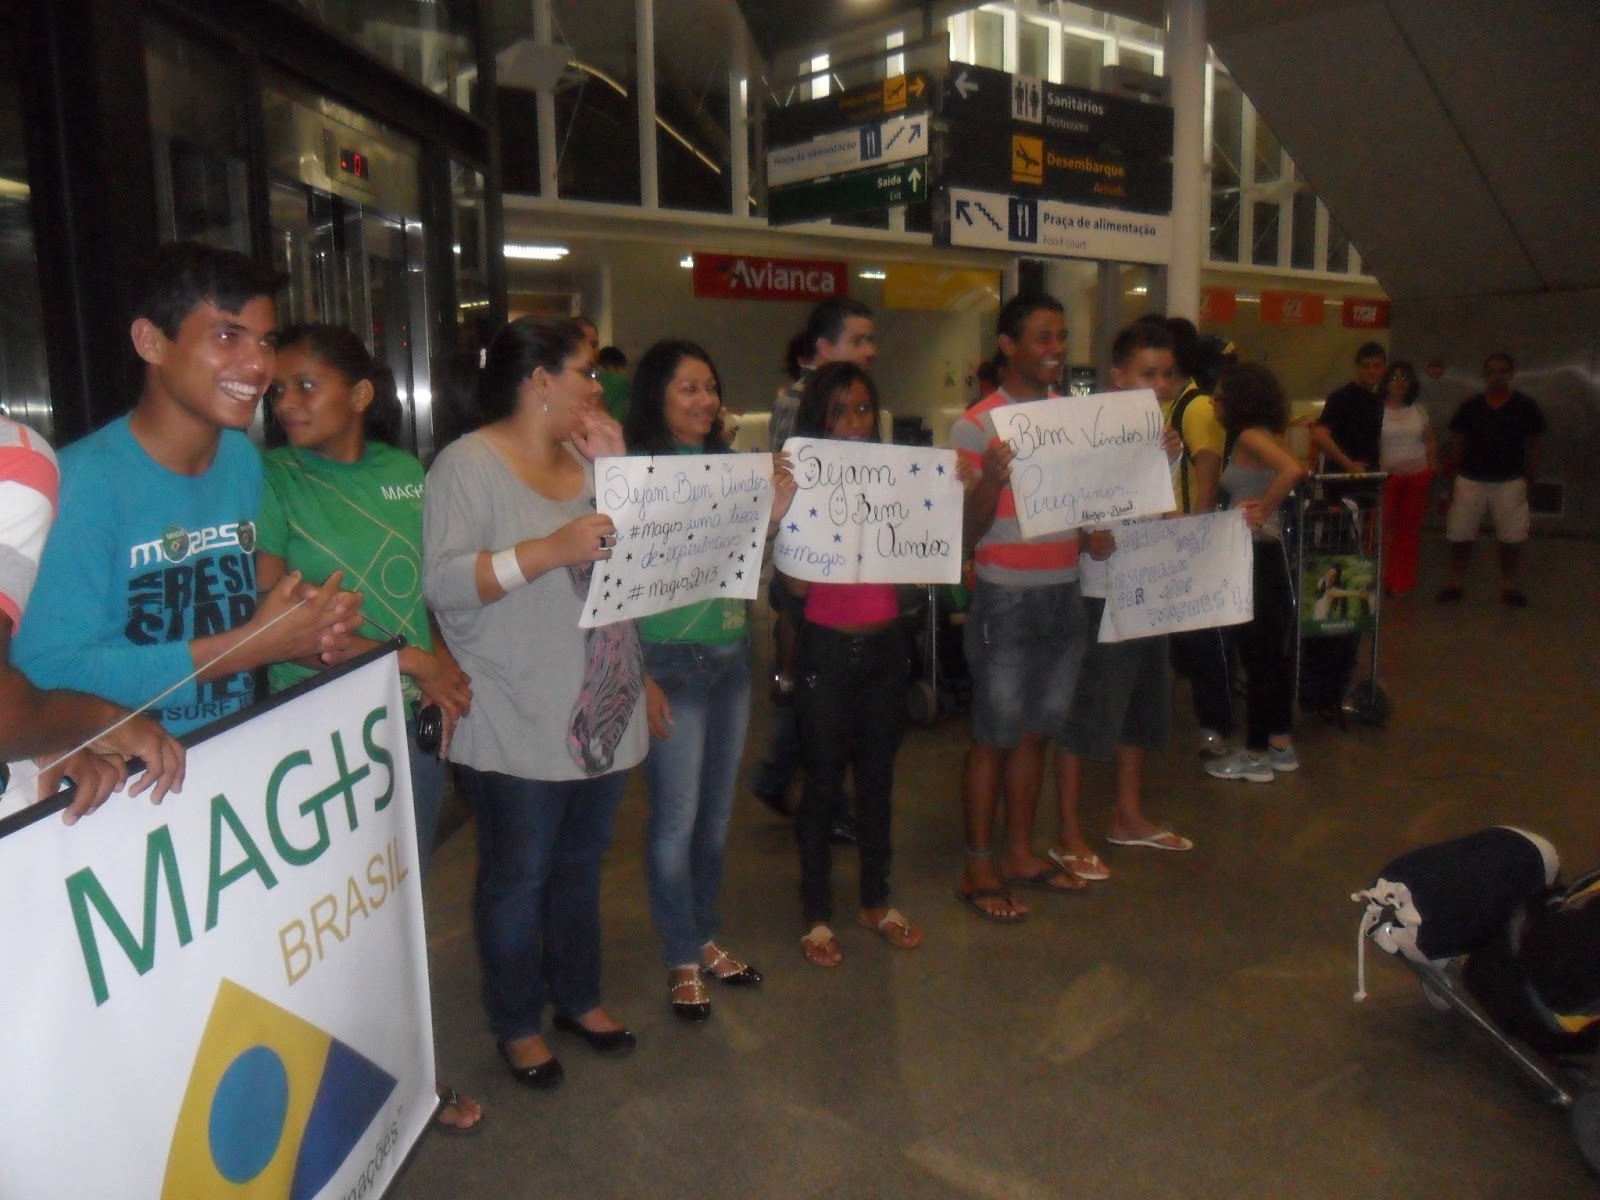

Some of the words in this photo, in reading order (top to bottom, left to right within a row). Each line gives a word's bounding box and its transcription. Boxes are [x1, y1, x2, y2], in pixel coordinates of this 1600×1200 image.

[1047, 92, 1104, 115] Sanitários
[1047, 152, 1125, 177] Desembarque
[877, 174, 902, 189] Saída
[1043, 212, 1074, 229] Praça
[1077, 216, 1091, 229] de
[1093, 218, 1156, 238] alimentação
[730, 260, 834, 293] Avianca
[1008, 413, 1073, 460] Bem
[673, 472, 713, 504] Bem
[852, 493, 909, 525] Bem
[278, 836, 408, 986] BRASIL
